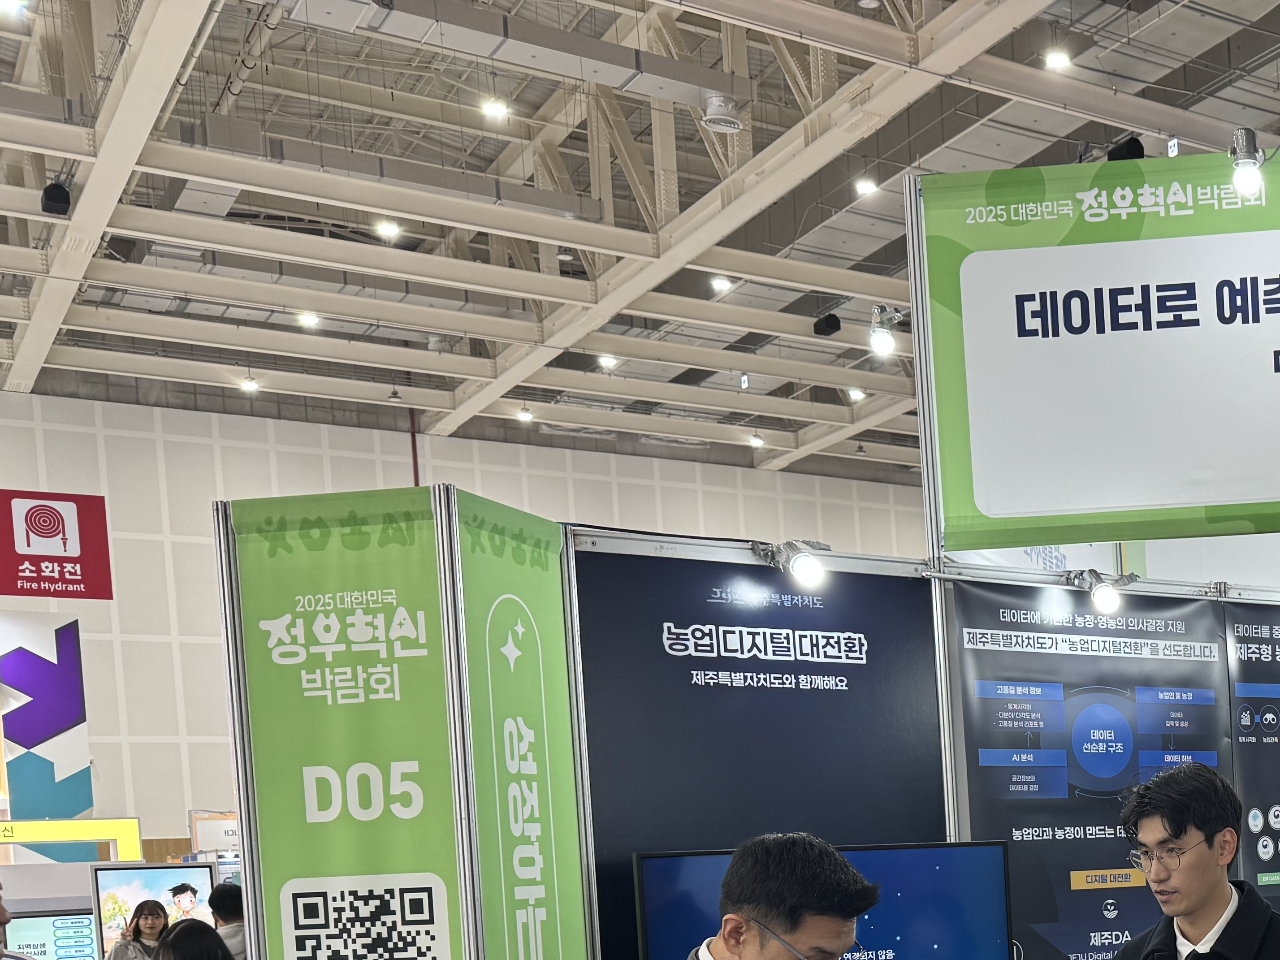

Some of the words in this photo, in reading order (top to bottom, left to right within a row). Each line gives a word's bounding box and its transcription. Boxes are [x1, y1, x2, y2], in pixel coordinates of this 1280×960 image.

[965, 206, 1006, 224] 2025
[1011, 200, 1073, 221] 대한민국
[1015, 282, 1200, 338] 데이터로
[18, 561, 82, 580] 소화전
[17, 580, 38, 590] Fire
[41, 582, 86, 592] Hydrant
[295, 594, 334, 612] 2025
[337, 588, 397, 609] 대한민국
[1000, 608, 1040, 625] 데이터에
[1075, 614, 1125, 630] 농정·영농의
[1127, 617, 1165, 632] 의사결정
[1167, 620, 1185, 634] 지원
[1234, 623, 1270, 639] 데이터를
[664, 623, 716, 656] 농업
[720, 628, 794, 660] 디지털
[796, 632, 866, 662] 대전환
[966, 631, 1059, 651] 제주특별자치도가
[1162, 643, 1216, 660] 선도합니다.
[1235, 643, 1273, 662] 제주형
[300, 663, 401, 705] 박람회
[691, 670, 797, 690] 제주특별자치도와
[798, 674, 849, 690] 함께해요
[1016, 685, 1029, 694] 분석
[1090, 730, 1114, 741] 데이터
[1083, 742, 1106, 754] 선순환
[1108, 743, 1124, 754] 구조
[1011, 754, 1020, 762] AI
[1020, 754, 1034, 762] 분석
[303, 761, 424, 824] D05
[1012, 827, 1053, 841] 농업인과
[1054, 826, 1084, 840] 농정이
[1086, 825, 1115, 839] 만드는
[1086, 873, 1108, 884] 디지털
[1110, 872, 1131, 883] 대전환
[1089, 930, 1132, 946] 제주DA
